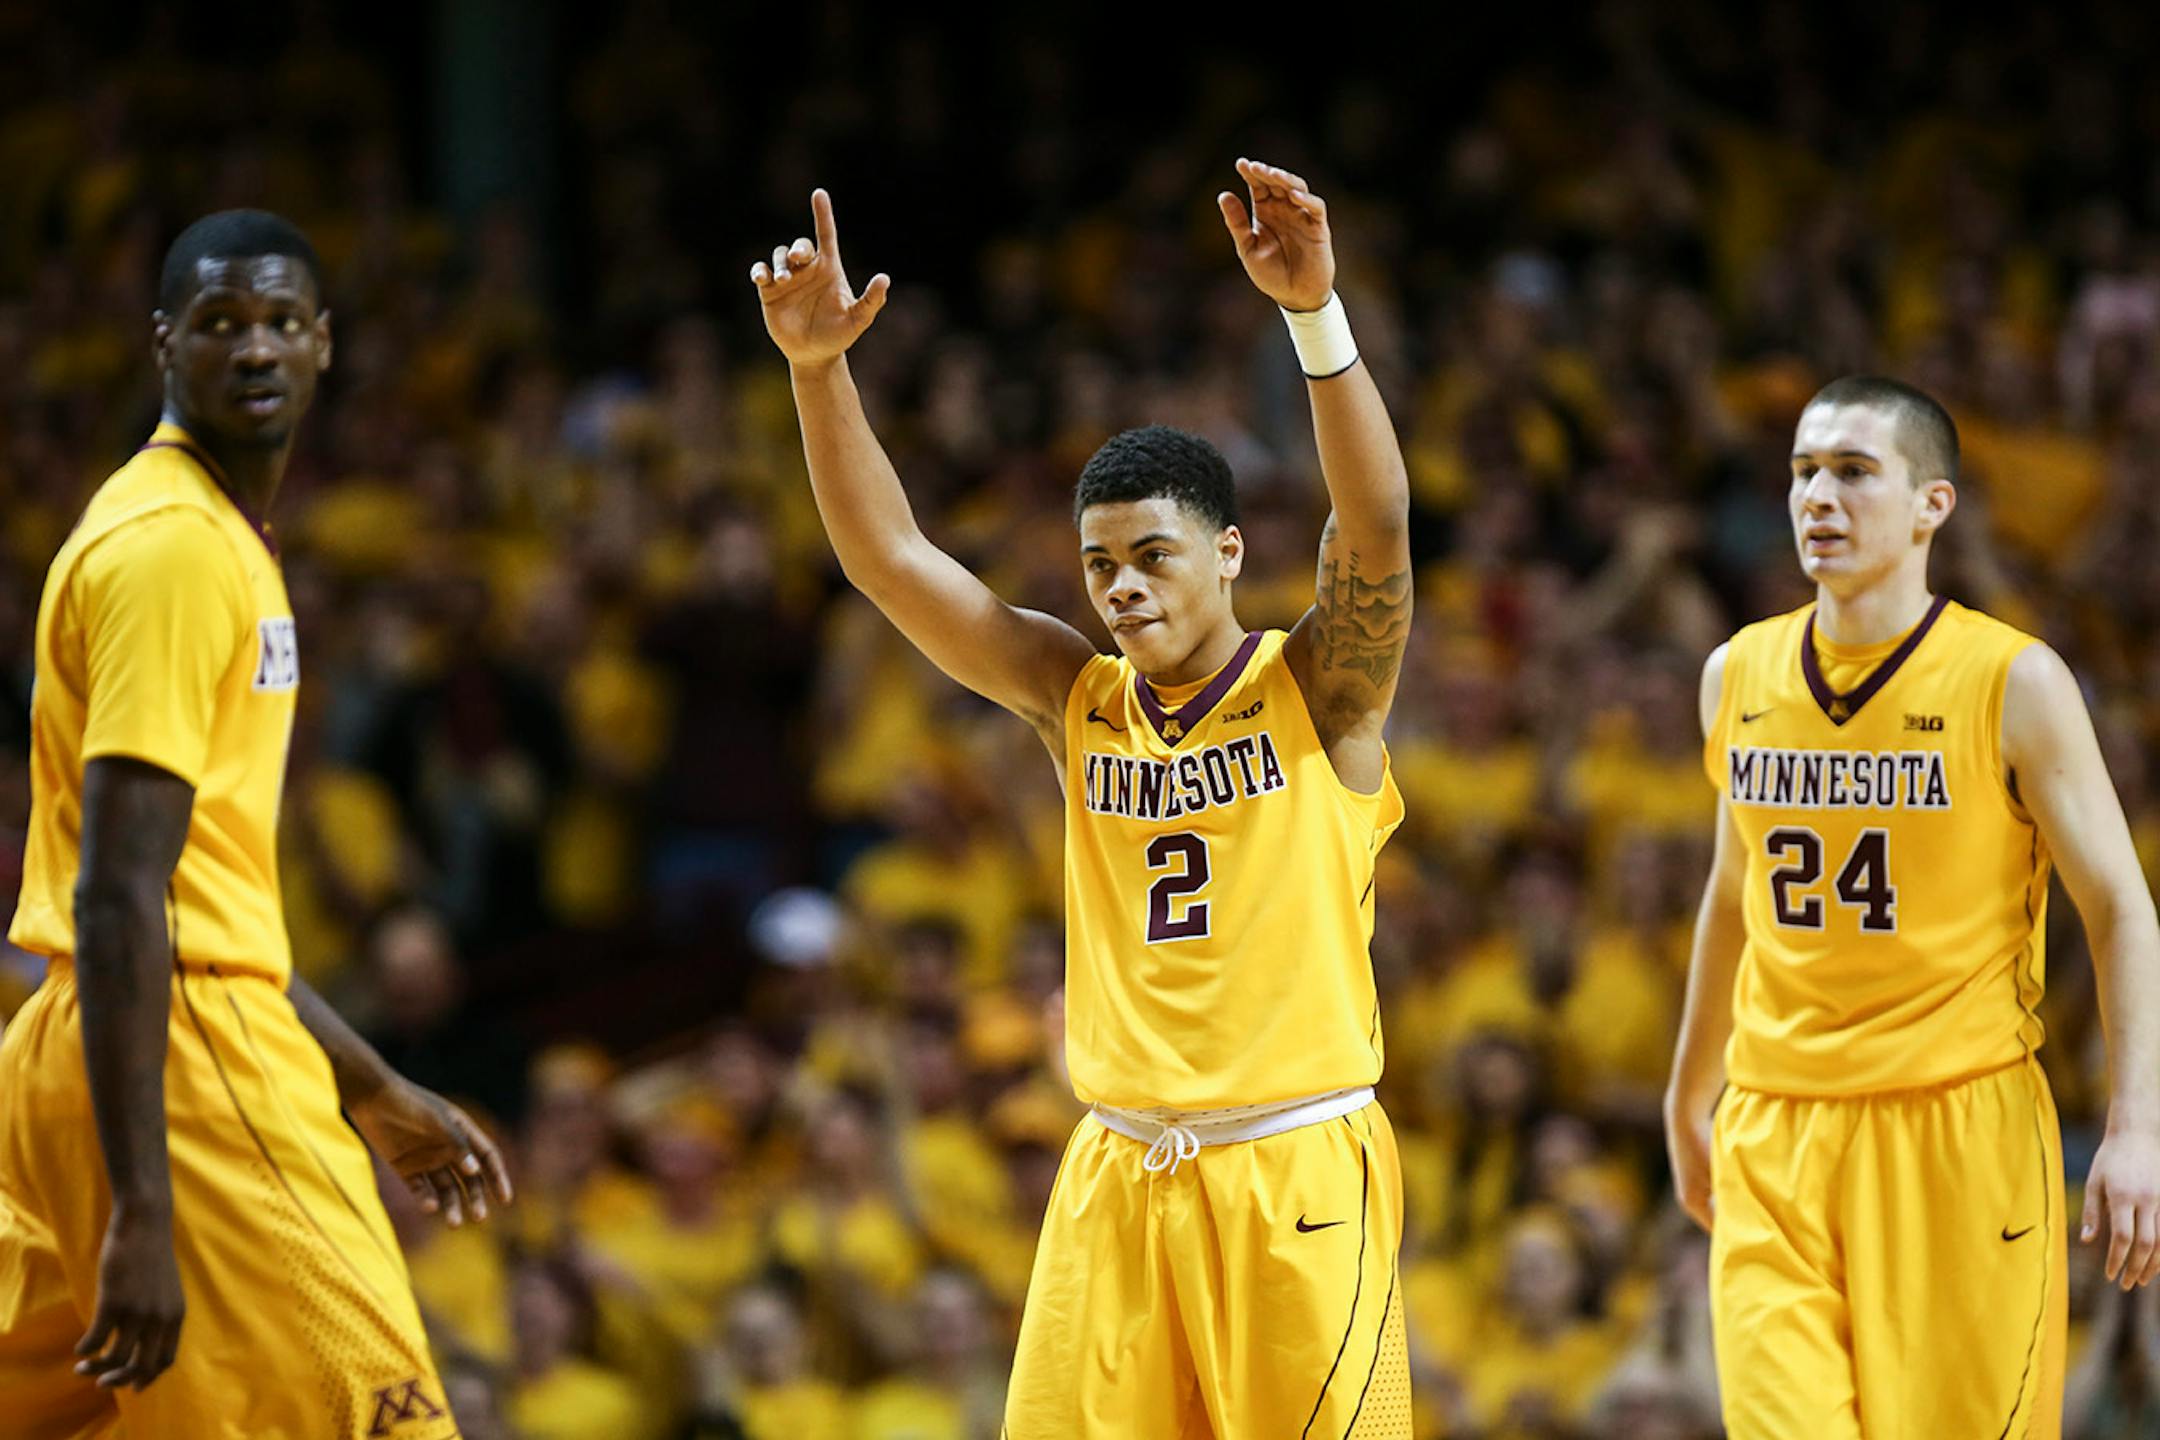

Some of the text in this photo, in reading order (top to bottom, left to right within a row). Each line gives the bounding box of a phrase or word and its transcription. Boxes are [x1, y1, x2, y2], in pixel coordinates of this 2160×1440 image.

[1083, 731, 1286, 821] MINNESOTA
[1729, 747, 1951, 808] MINNESOTA
[1145, 830, 1212, 945] 2
[1765, 825, 1897, 932] 24
